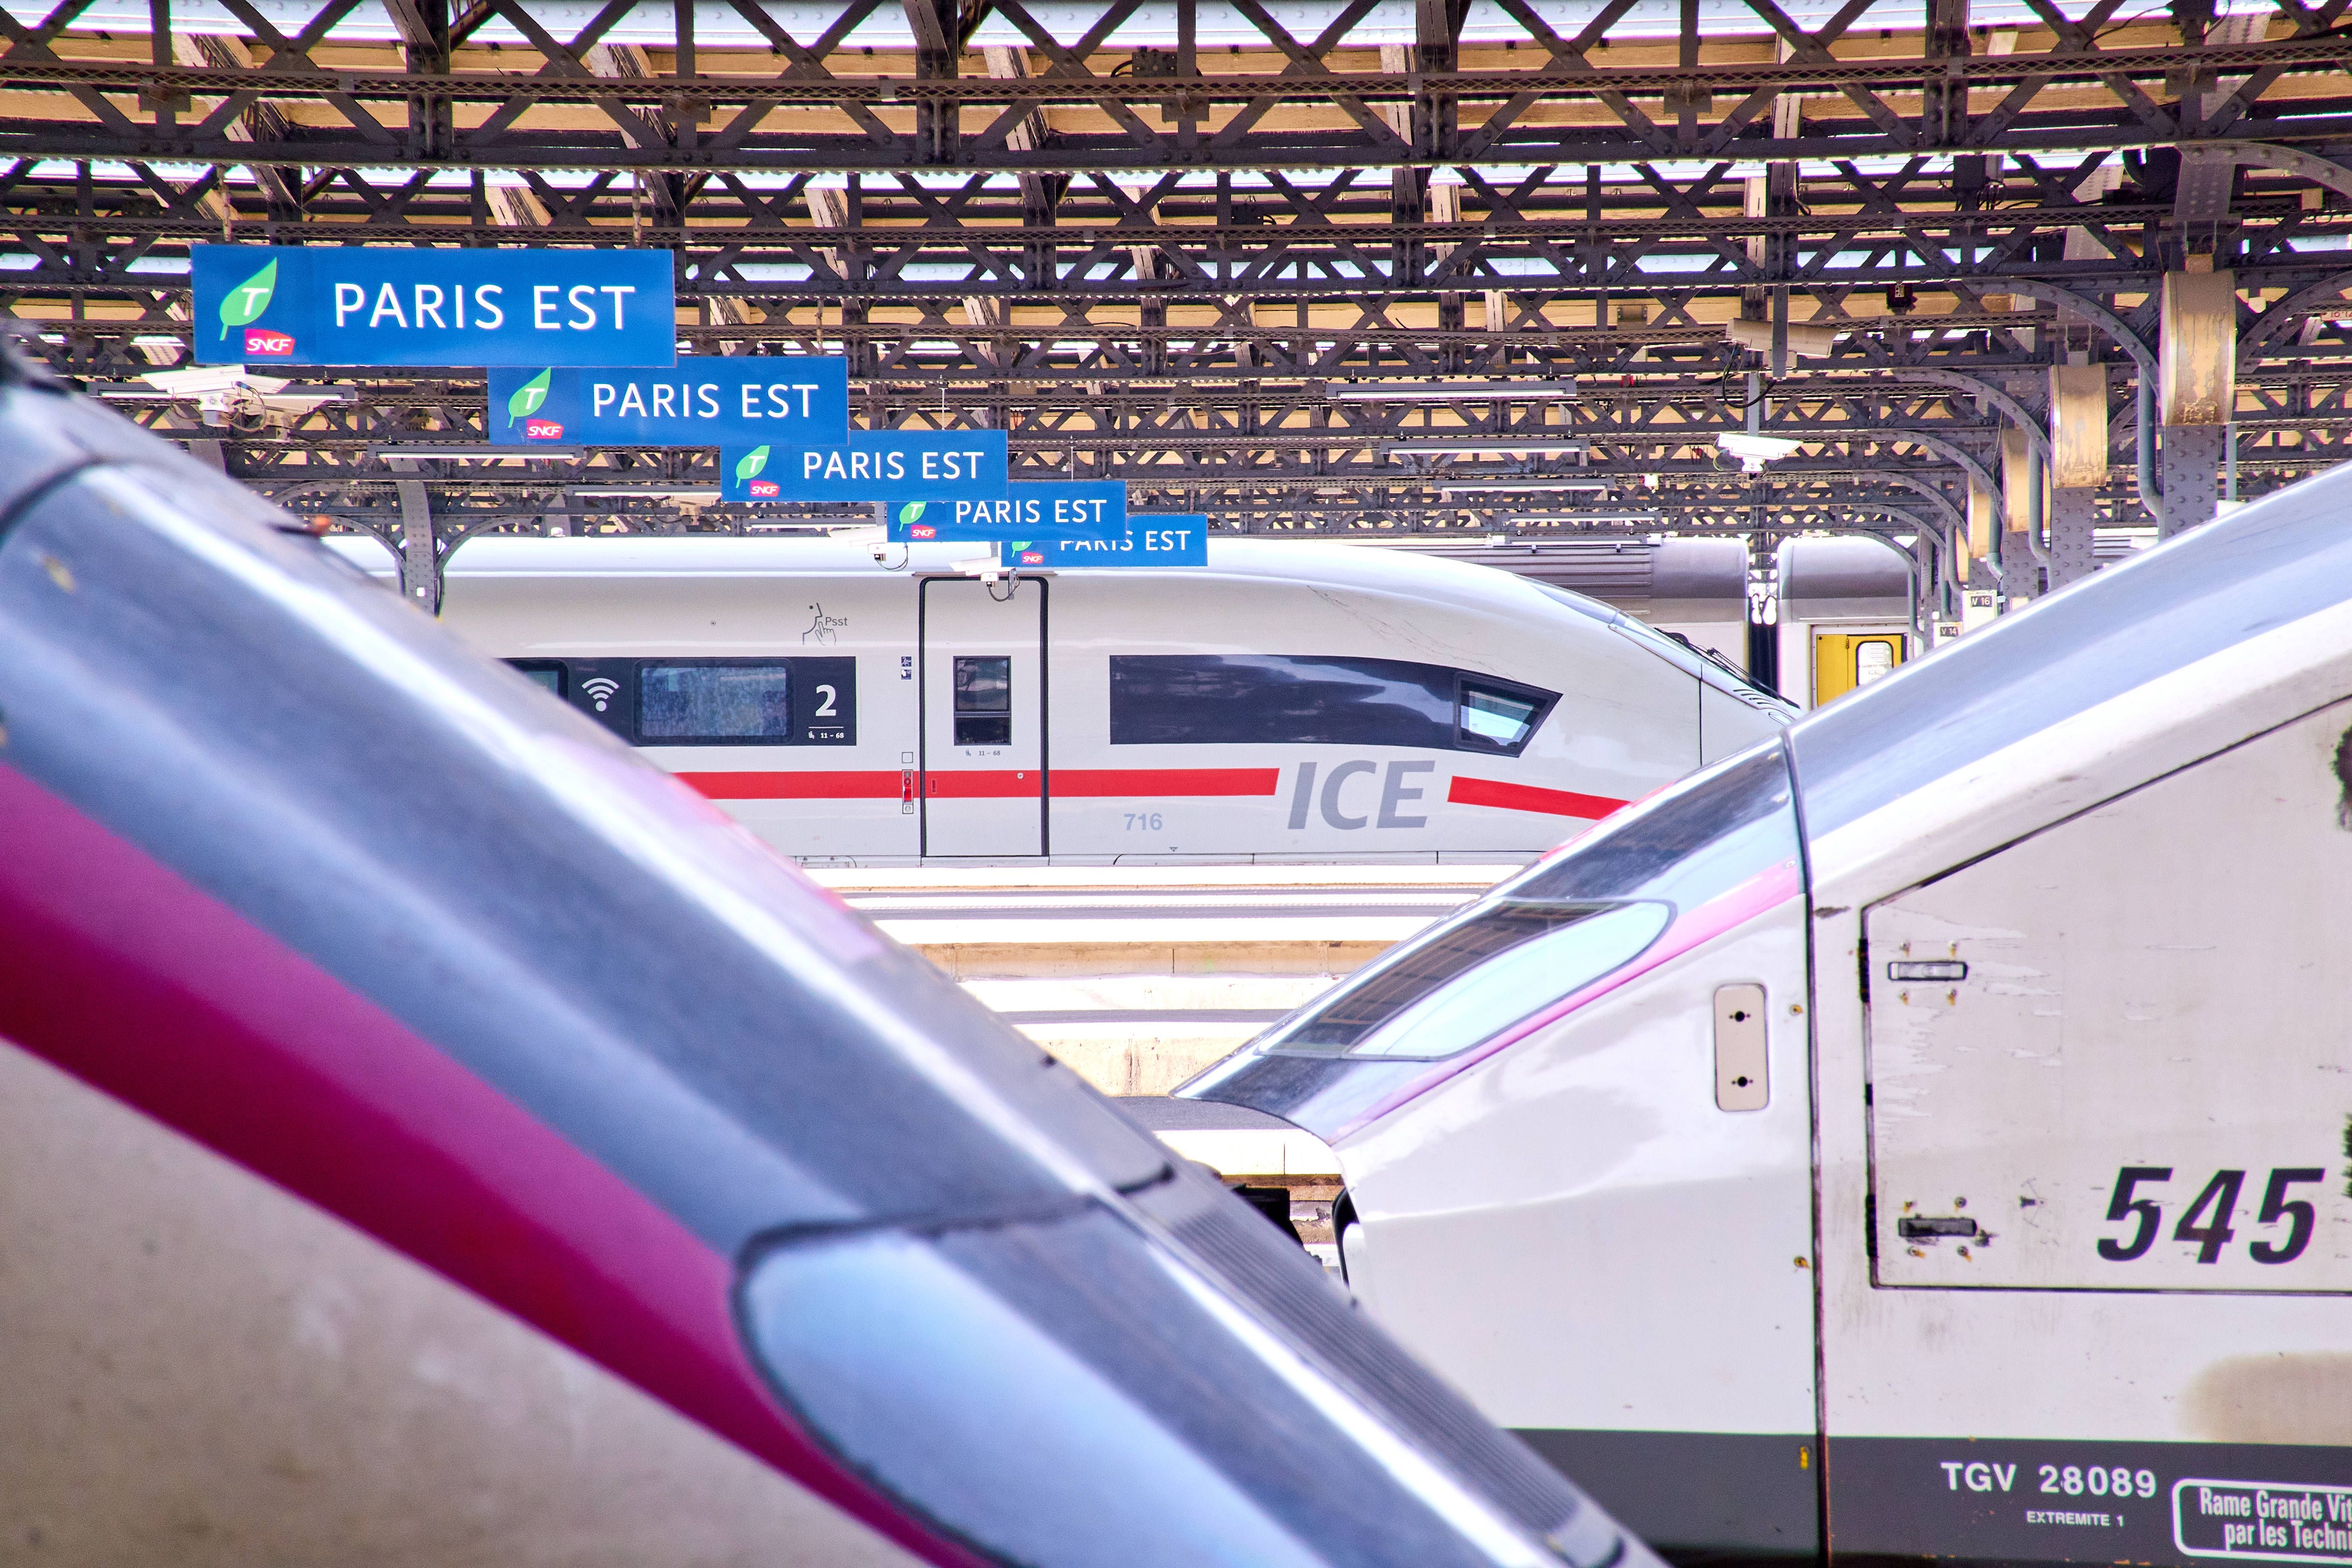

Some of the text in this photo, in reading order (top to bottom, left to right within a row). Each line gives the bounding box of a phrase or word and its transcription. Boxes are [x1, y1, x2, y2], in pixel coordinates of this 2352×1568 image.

[335, 282, 636, 331] PARIS EST
[247, 338, 292, 352] SNCF
[593, 383, 819, 418] PARIS EST
[528, 426, 561, 437] SNCF
[803, 451, 985, 479] PARIS EST
[750, 485, 778, 495] SNCF
[956, 499, 1107, 524] PARIS EST
[912, 529, 935, 537] SNCF
[1145, 530, 1191, 551] EST
[1981, 597, 1990, 605] 16
[825, 616, 848, 626] Psst
[815, 684, 836, 717] 2
[1287, 760, 1436, 830] ICE
[1124, 813, 1163, 831] 716
[2097, 1167, 2326, 1265] 545
[1940, 1462, 2156, 1498] TGV 28089
[2200, 1487, 2251, 1517] Rame
[2256, 1489, 2323, 1521] Grande
[2026, 1510, 2123, 1527] EXTREMITE 1
[2224, 1524, 2254, 1551] par
[2259, 1519, 2288, 1547] les
